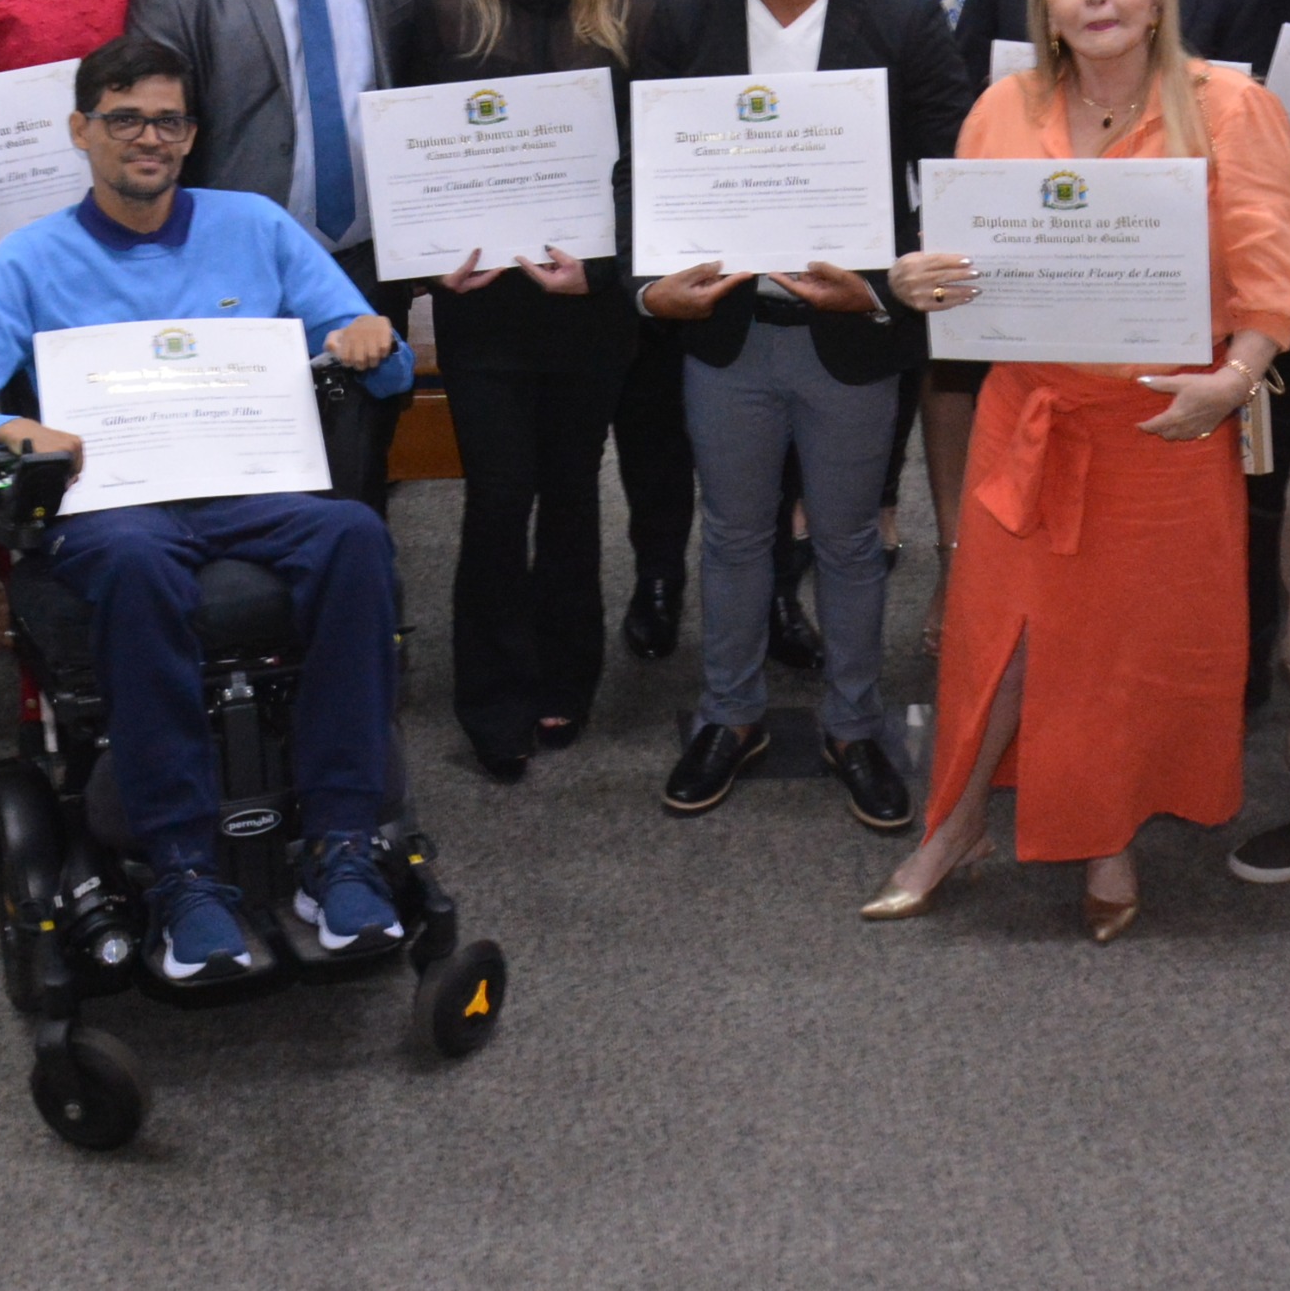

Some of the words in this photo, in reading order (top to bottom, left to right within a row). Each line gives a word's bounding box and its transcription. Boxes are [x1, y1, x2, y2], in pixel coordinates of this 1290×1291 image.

[972, 216, 1026, 228] Diploma
[1031, 217, 1045, 228] de
[1050, 216, 1091, 228] Honra
[1096, 218, 1109, 227] ao
[1034, 233, 1083, 243] Municipal
[995, 267, 1034, 277] Fátima
[1038, 268, 1084, 279] Siqueira
[1087, 268, 1124, 280] Fleury
[1128, 268, 1142, 277] de
[1145, 268, 1181, 277] Lemos
[228, 814, 275, 831] permobil
